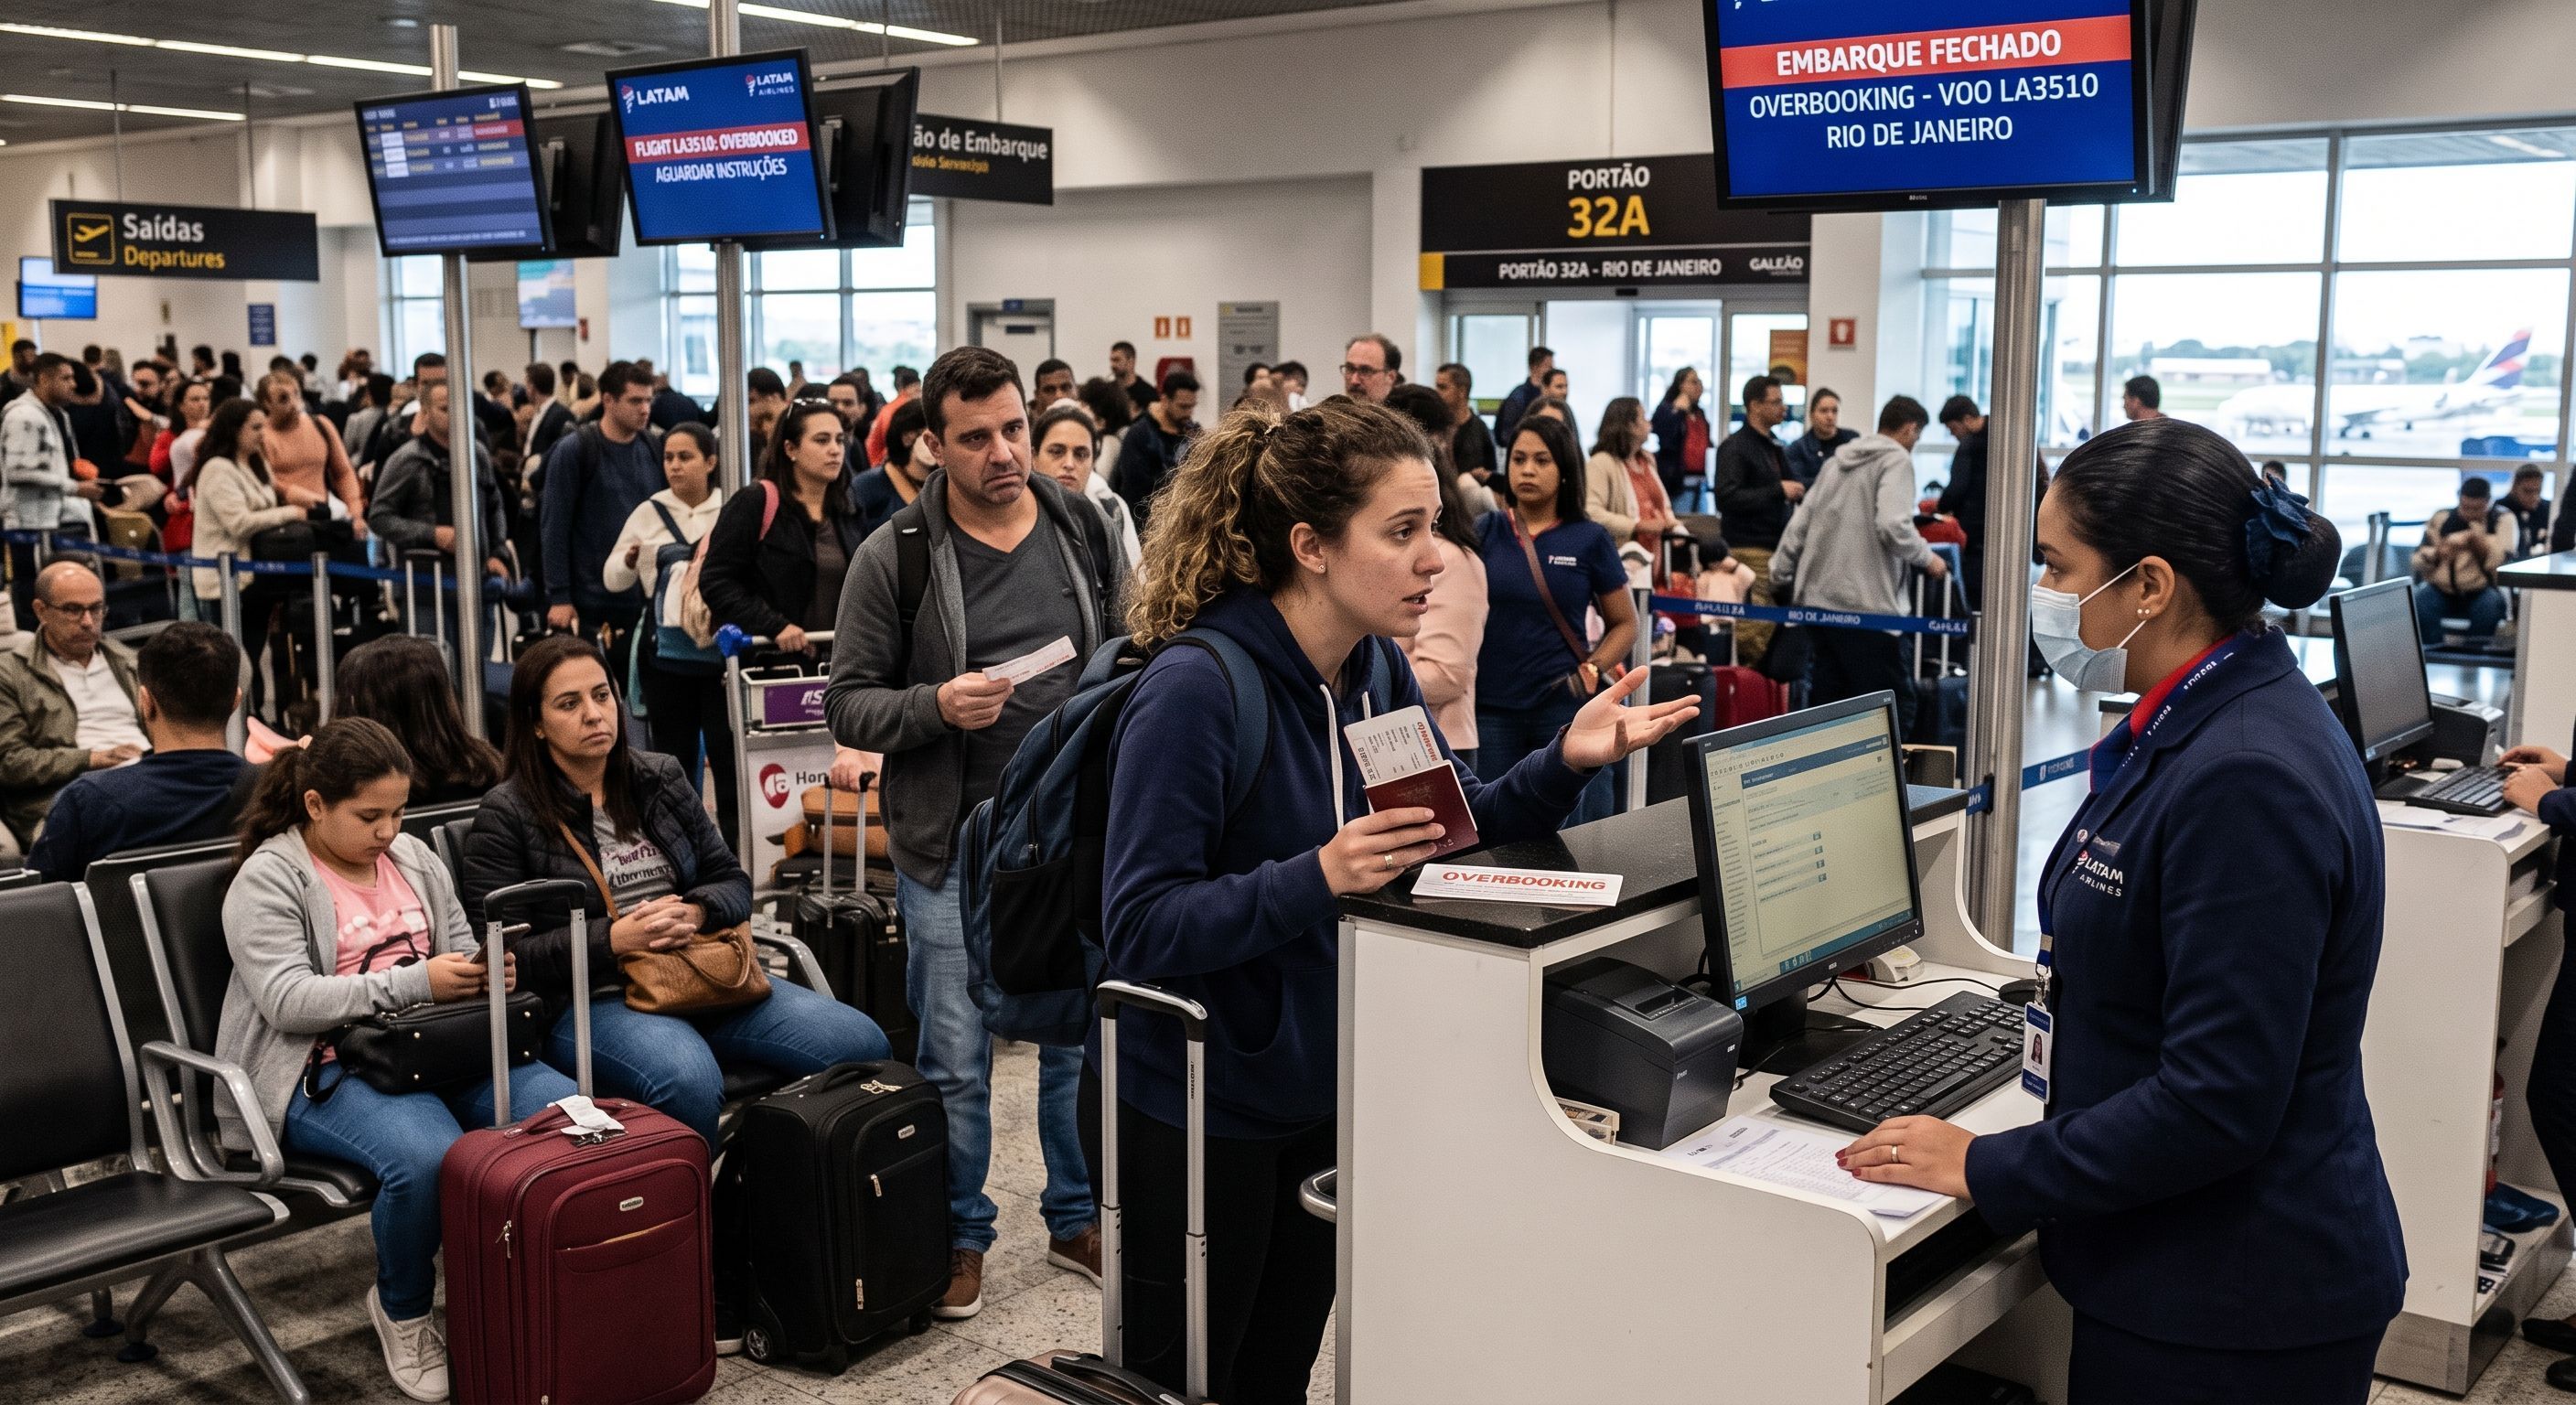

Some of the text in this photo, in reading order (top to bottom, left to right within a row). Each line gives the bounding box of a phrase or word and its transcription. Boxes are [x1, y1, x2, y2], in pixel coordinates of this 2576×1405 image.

[1776, 28, 2062, 76] EMBARQUE FECHADO
[757, 72, 794, 86] LATAM
[636, 85, 690, 105] LATAM
[1749, 85, 1915, 118] OVERBOOKING
[1938, 79, 1992, 107] VOO
[2001, 72, 2099, 102] LA3510
[634, 128, 799, 158] FLIGHT LA3510: OVERBOOKED
[938, 126, 961, 153] de
[964, 129, 1048, 163] Embarque
[1827, 115, 2013, 148] RIO DE JANEIRO
[655, 155, 788, 183] AGUARDAR INSTRUÇÕES
[1567, 163, 1651, 190] PORTÃO
[122, 212, 205, 243] Saídas
[1567, 194, 1651, 239] 32A
[123, 244, 226, 273] Departures
[1498, 258, 1559, 280] PORTÃO
[1560, 261, 1590, 279] 32A
[1602, 260, 1629, 278] RIO
[1631, 259, 1653, 277] DE
[1655, 257, 1723, 277] JANEIRO
[1748, 253, 1804, 272] GALEÃO
[1442, 871, 1606, 891] OVERBOOKING
[2084, 857, 2123, 885] LATAM
